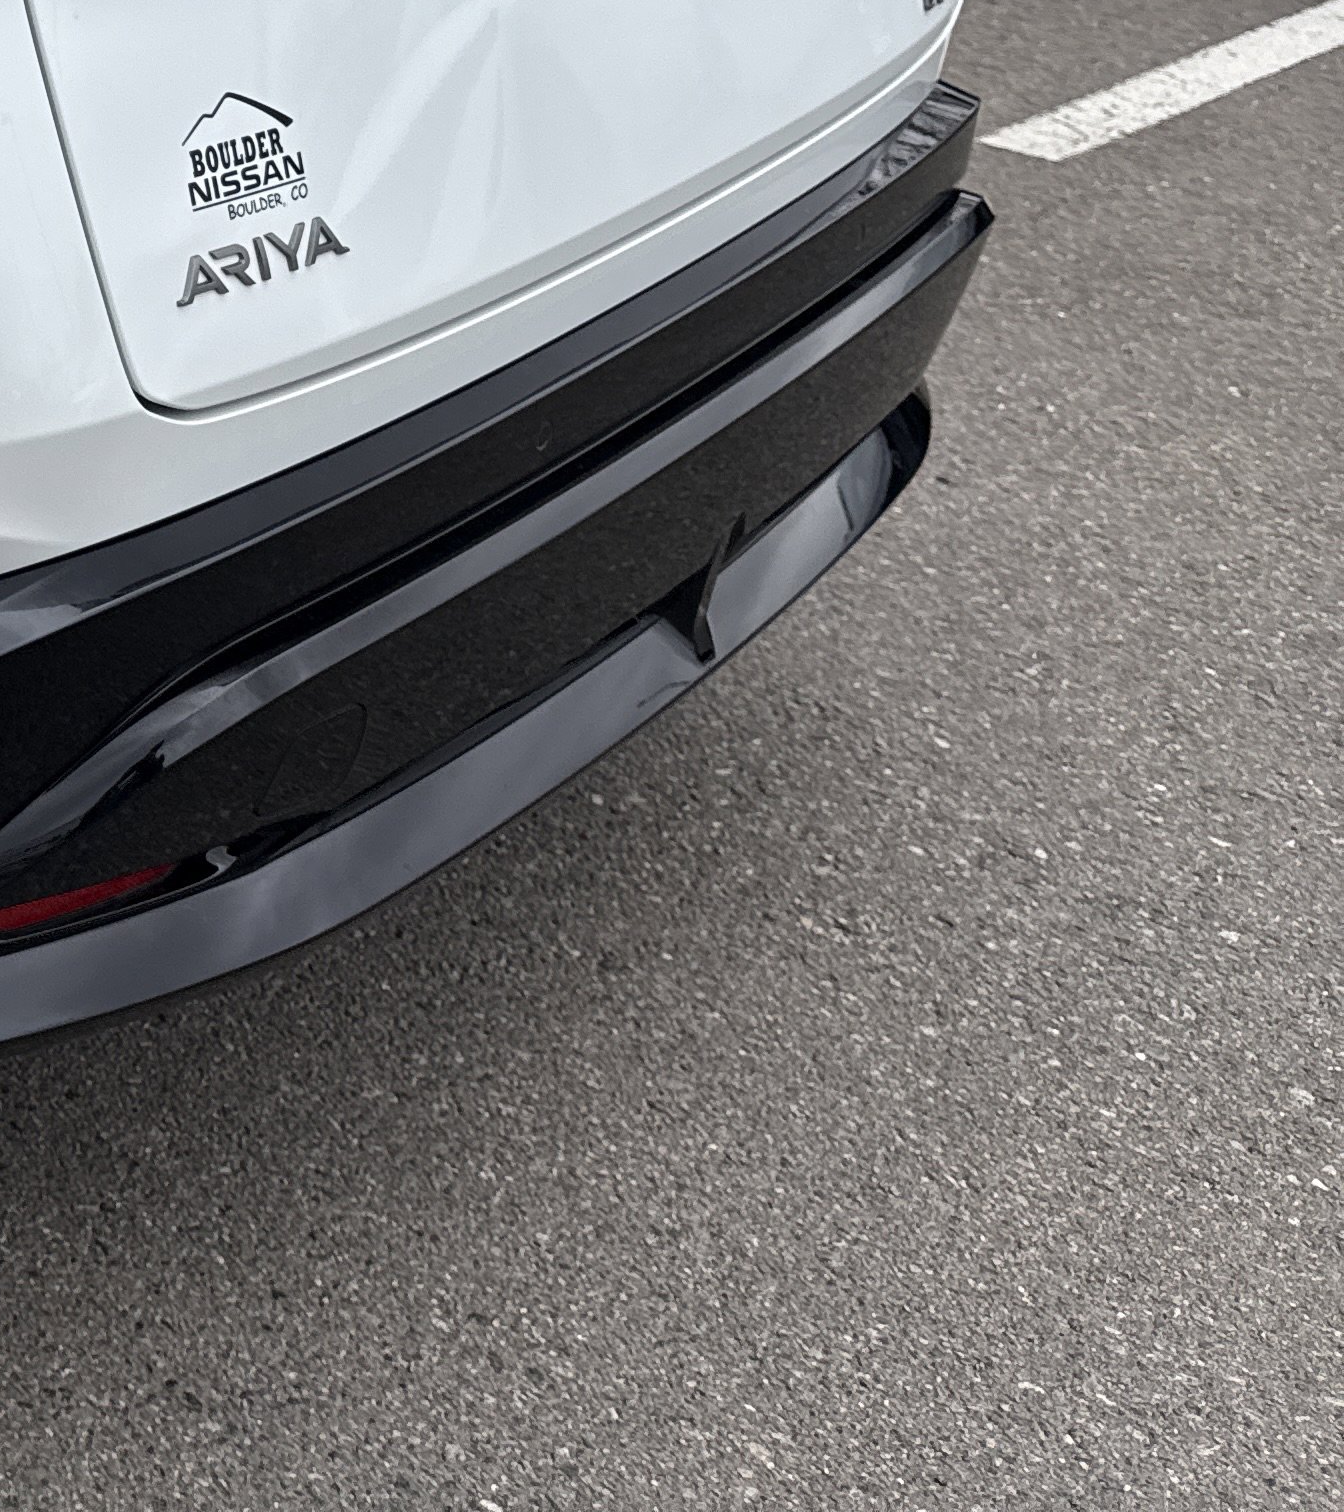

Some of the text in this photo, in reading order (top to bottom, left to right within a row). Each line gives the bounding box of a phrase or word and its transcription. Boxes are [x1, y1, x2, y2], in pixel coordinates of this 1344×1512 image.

[188, 127, 284, 178] BOULDER
[188, 151, 305, 207] NISSAN
[290, 182, 309, 202] CO
[176, 216, 351, 308] ARIYA
